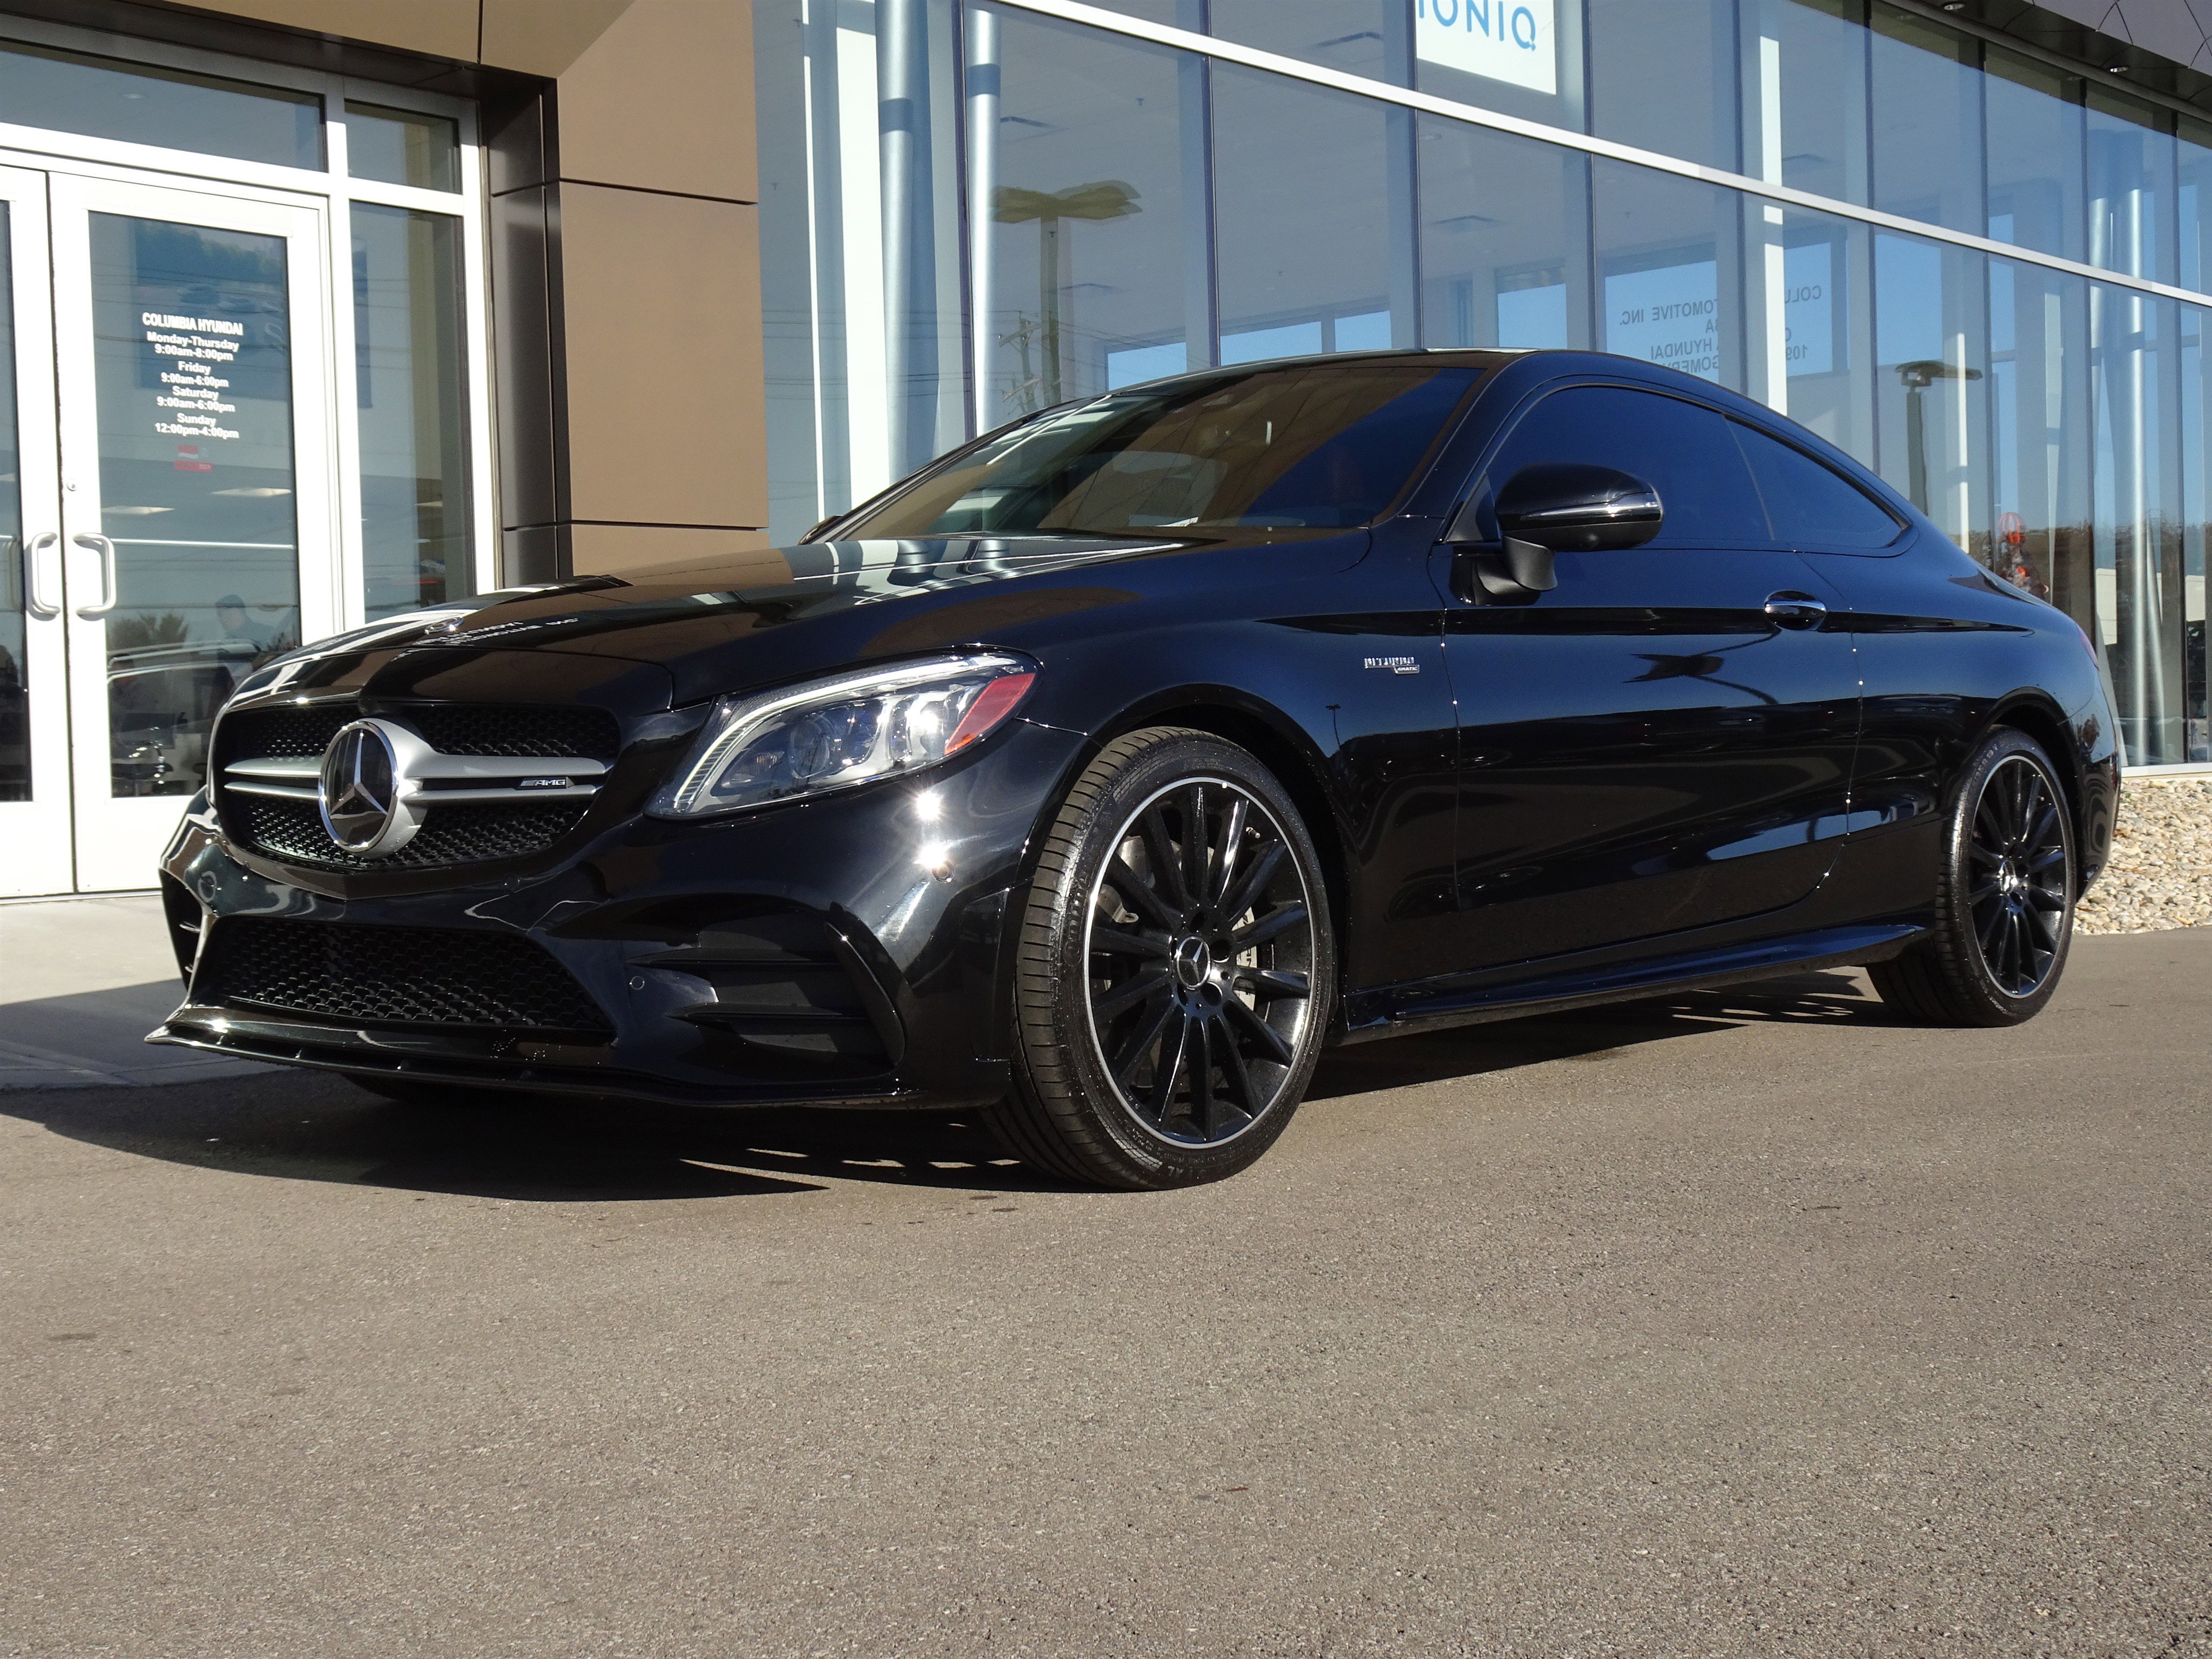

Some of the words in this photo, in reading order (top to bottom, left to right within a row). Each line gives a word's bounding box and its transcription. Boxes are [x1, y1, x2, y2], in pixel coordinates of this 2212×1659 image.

[142, 312, 197, 331] COLUMBIA
[198, 318, 243, 335] HYUNDAI
[147, 331, 239, 352] Monday-Thursday
[178, 361, 211, 375] Friday
[172, 386, 219, 401] Saturday
[177, 413, 216, 427] Sunday
[155, 422, 239, 440] 12:00pm-4:00pm
